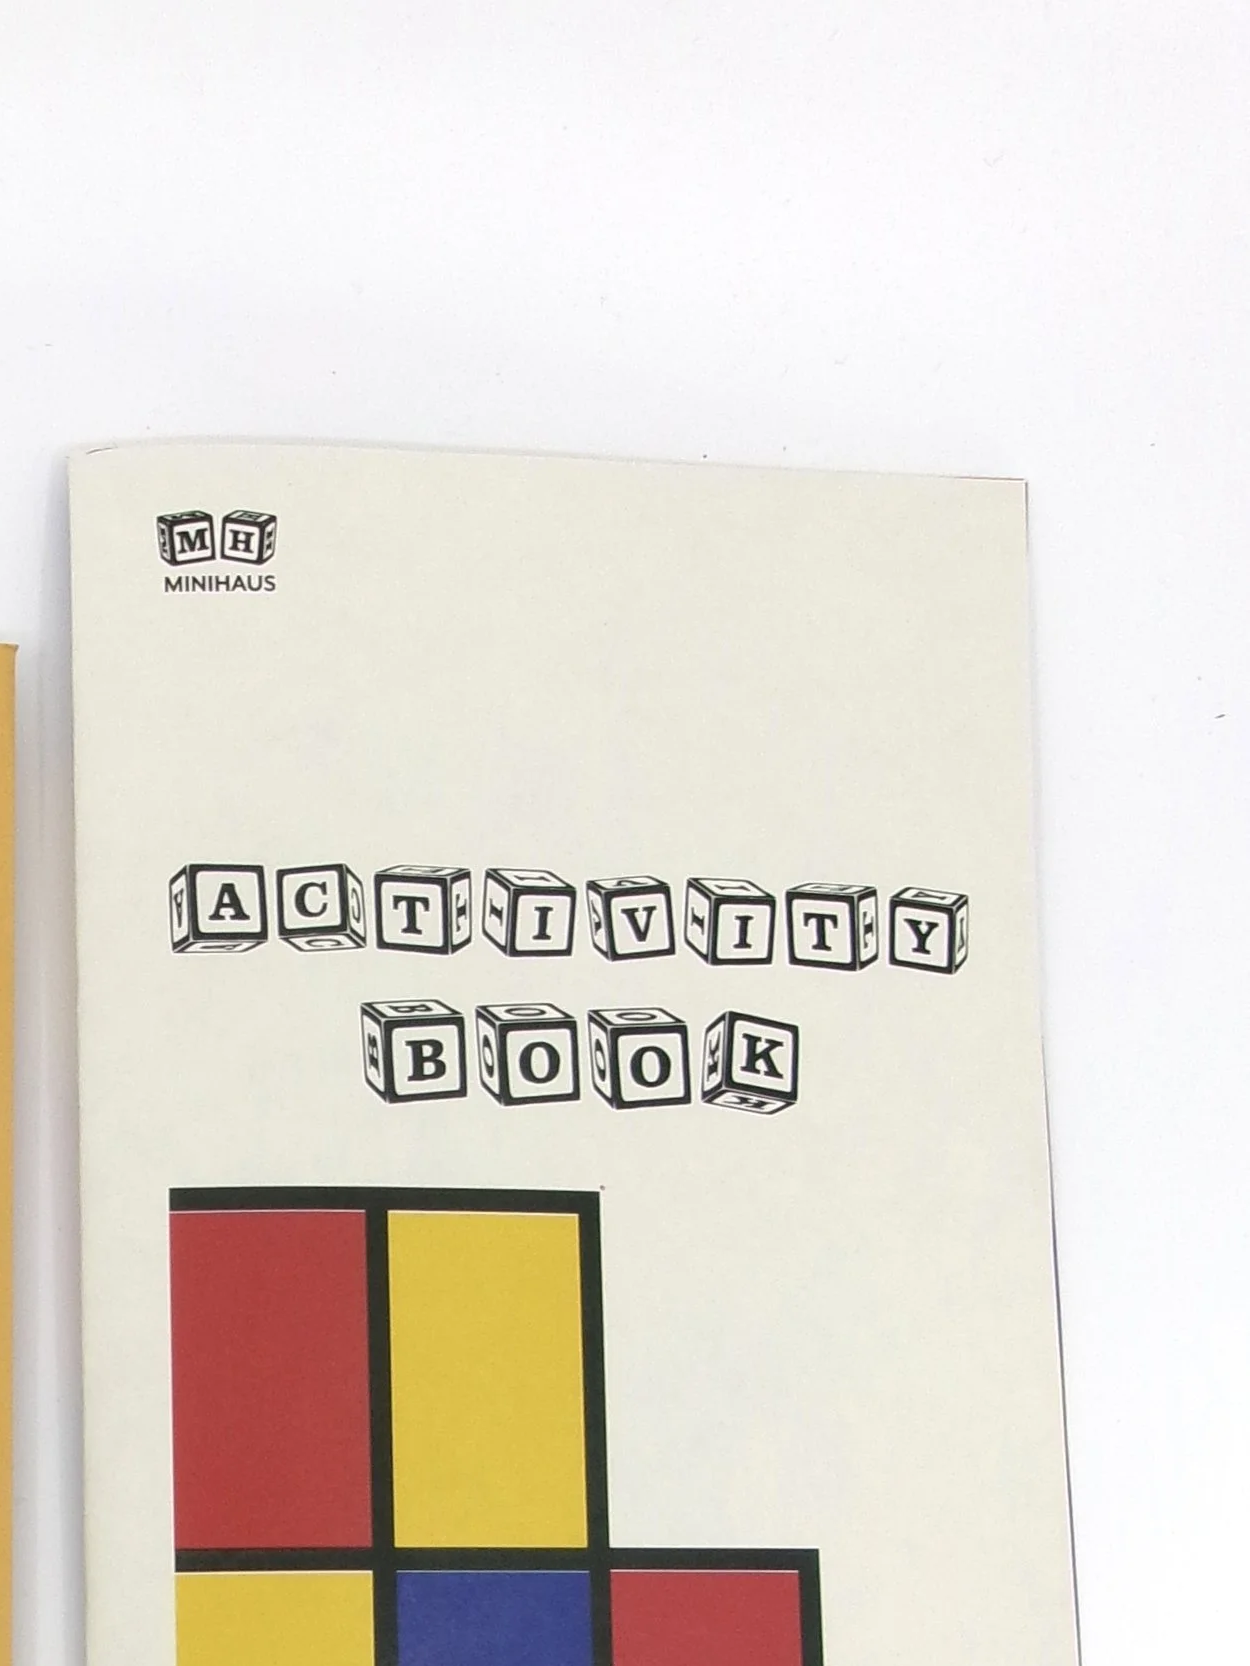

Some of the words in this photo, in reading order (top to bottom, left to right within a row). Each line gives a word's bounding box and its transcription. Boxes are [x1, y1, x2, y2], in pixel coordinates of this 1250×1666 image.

[164, 574, 276, 593] MINIHAUS
[206, 880, 941, 956] ACTIVITY
[403, 1031, 786, 1089] BOOK
